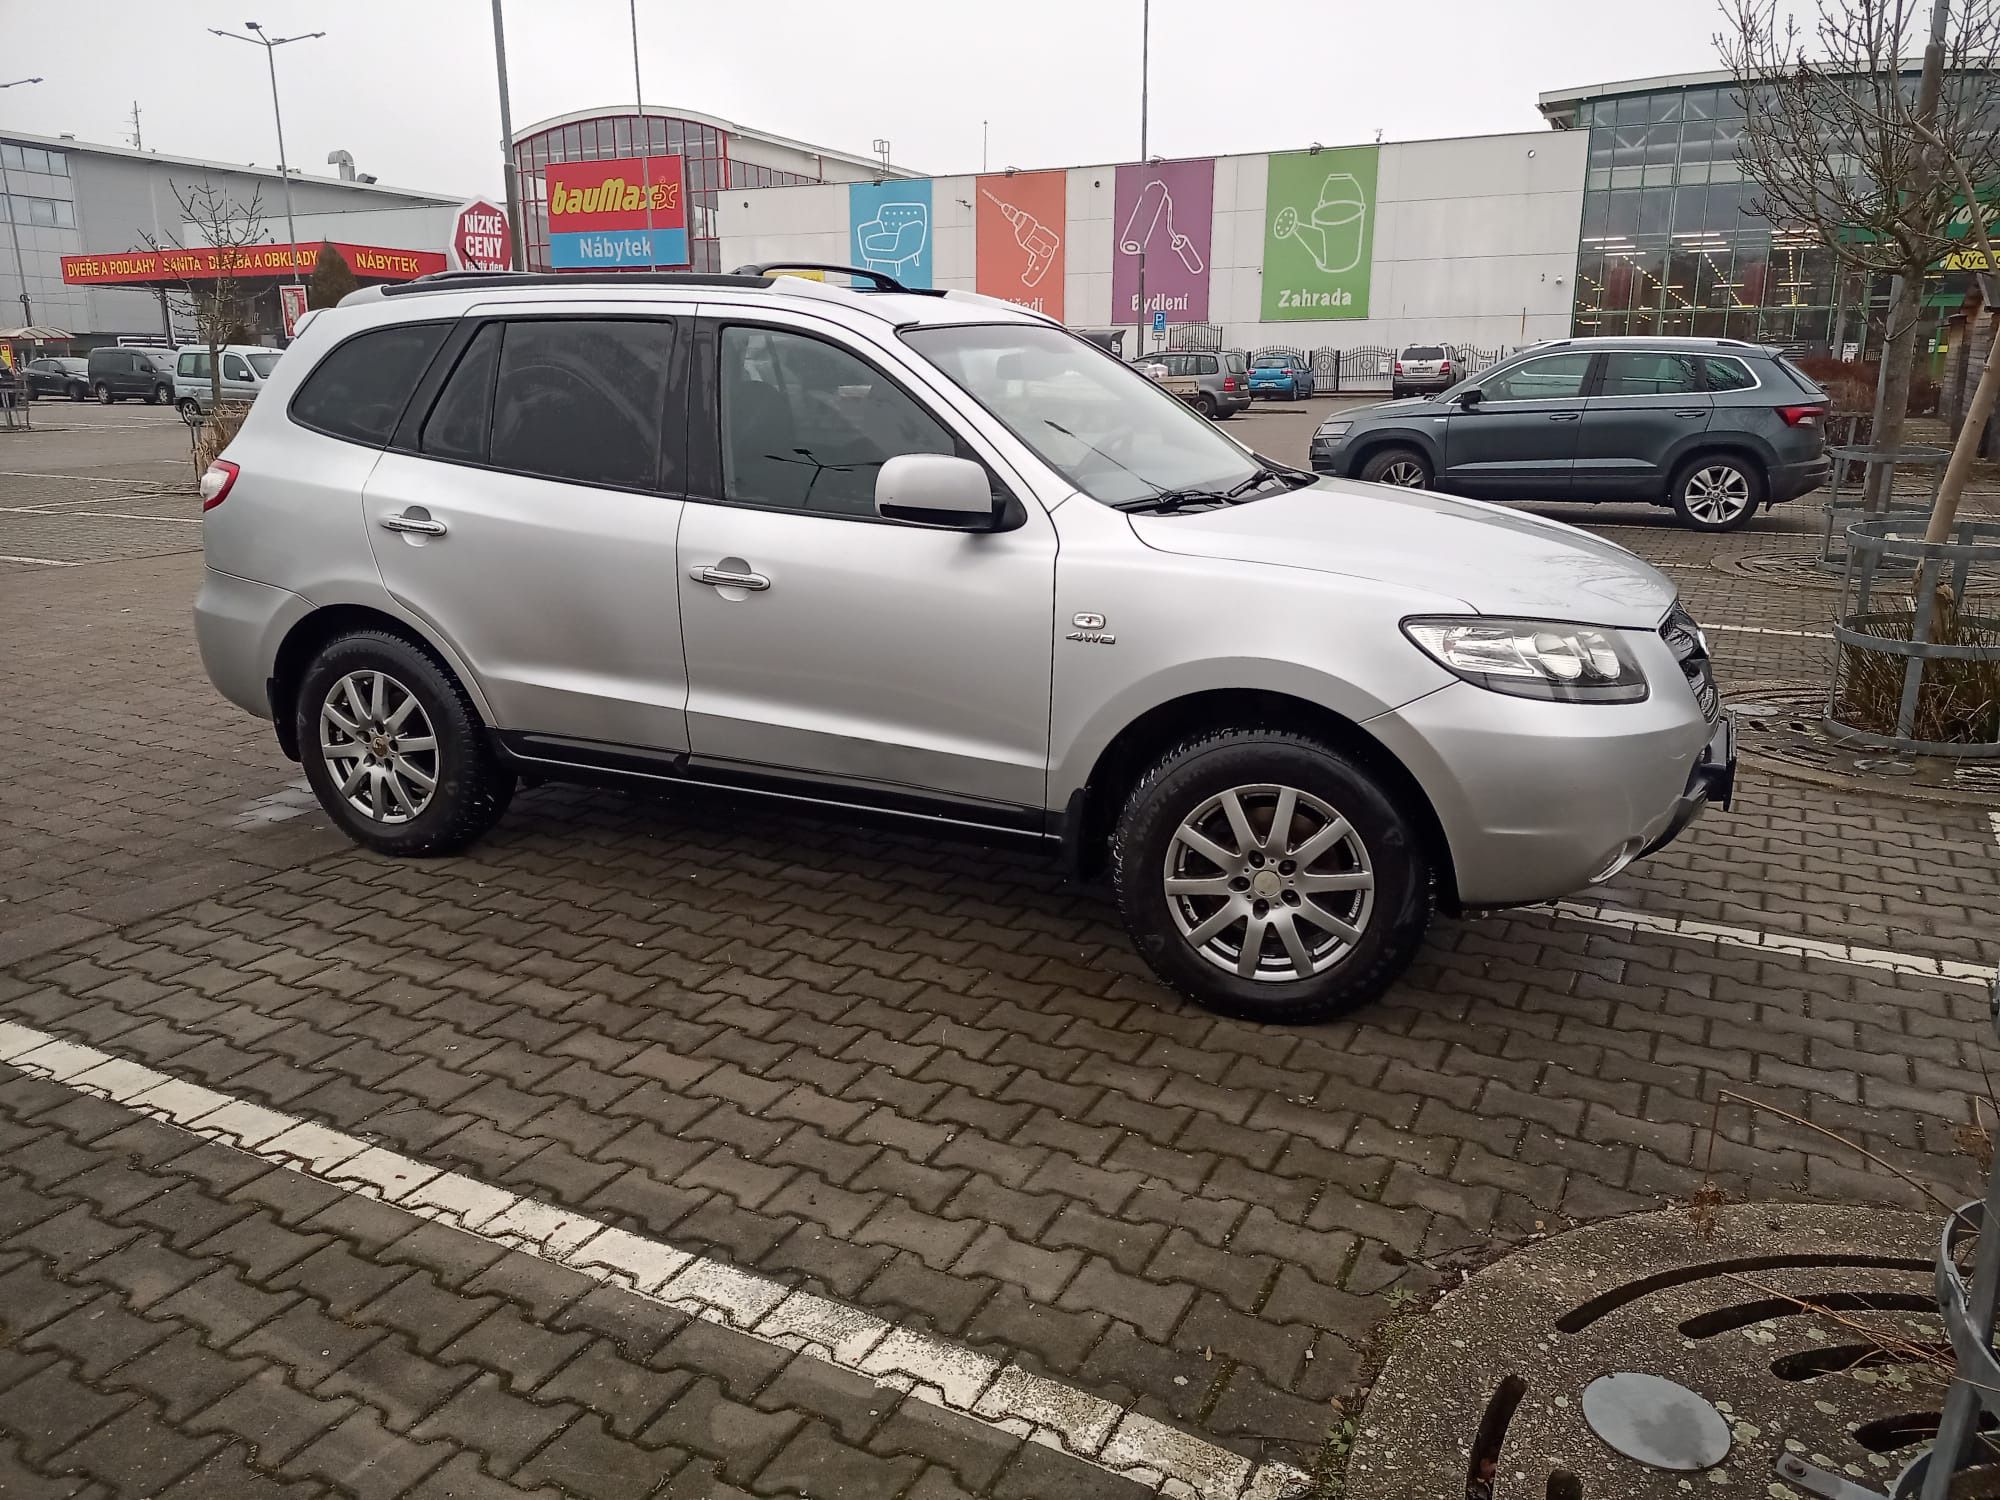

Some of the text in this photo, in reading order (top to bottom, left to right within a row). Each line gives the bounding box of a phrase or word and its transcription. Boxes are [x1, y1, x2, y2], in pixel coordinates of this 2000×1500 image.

[464, 210, 502, 236] NÍZKÉ
[465, 236, 503, 259] CENY
[580, 236, 652, 262] Nábytek
[67, 258, 155, 277] DVEŘE A PODLAHY
[163, 256, 202, 272] SANITA
[254, 253, 262, 268] A
[264, 250, 318, 267] OBKLADY
[356, 250, 419, 273] NÁBYTEK
[1131, 292, 1188, 315] Bydlení
[1278, 287, 1352, 308] Zahrada
[1155, 313, 1164, 326] P
